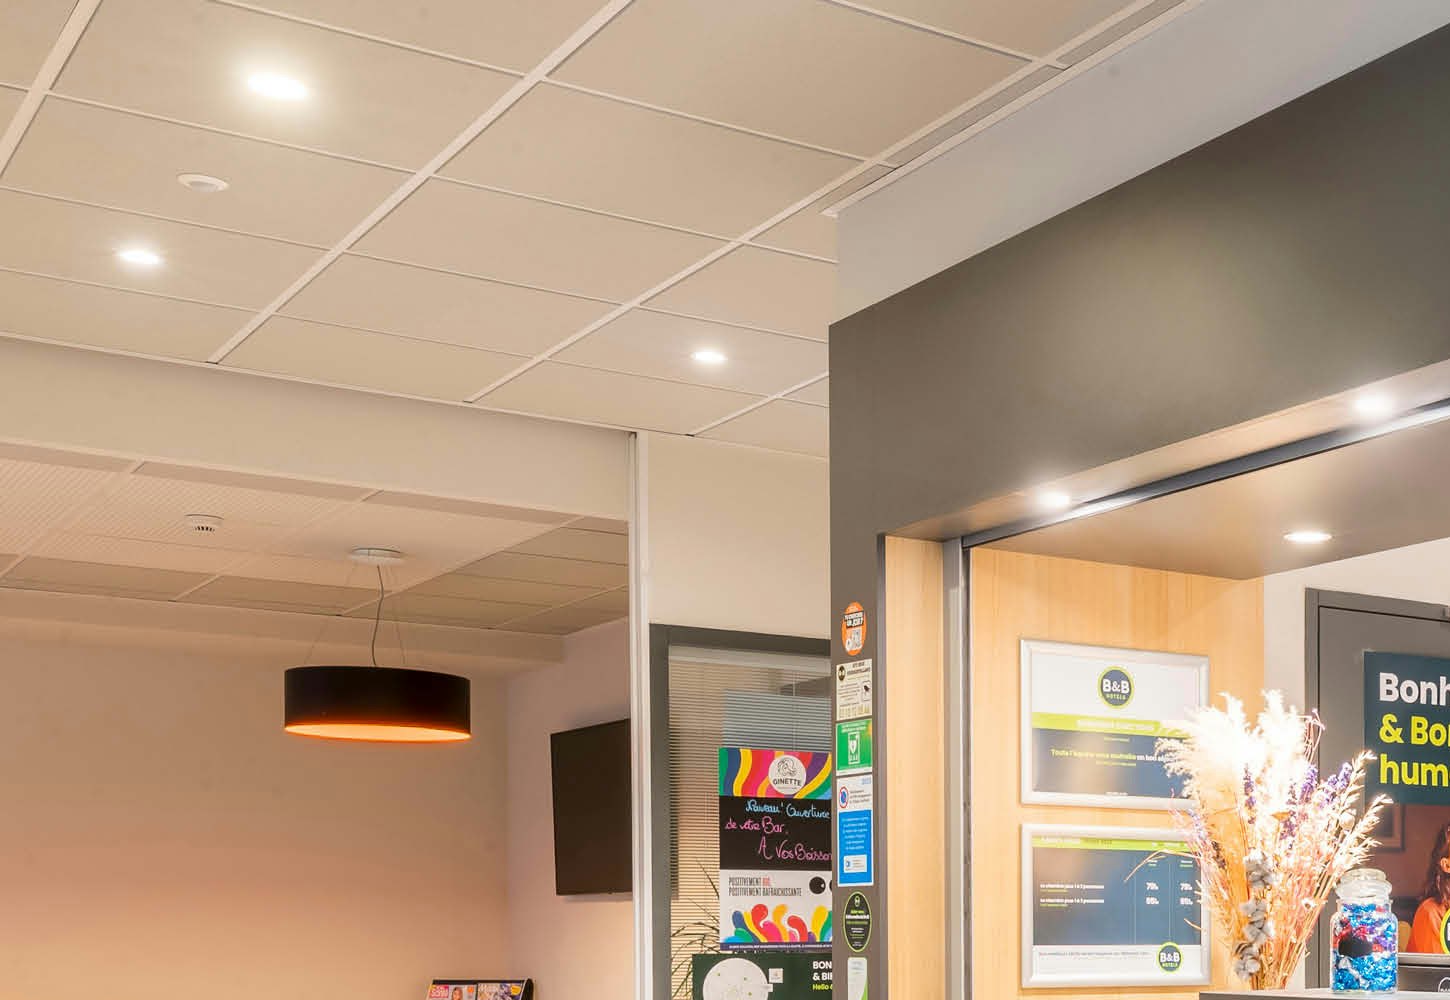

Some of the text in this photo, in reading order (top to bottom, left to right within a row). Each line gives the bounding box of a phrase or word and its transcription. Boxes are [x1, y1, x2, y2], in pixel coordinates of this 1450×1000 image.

[1102, 678, 1130, 694] B&B
[1379, 713, 1404, 744] &
[772, 778, 801, 786] GINETTE
[725, 817, 737, 829] de
[775, 840, 794, 860] Vos
[729, 876, 762, 887] POSITIVEMENT
[729, 887, 762, 896] POSITIVEMENT
[1159, 951, 1181, 962] B&B
